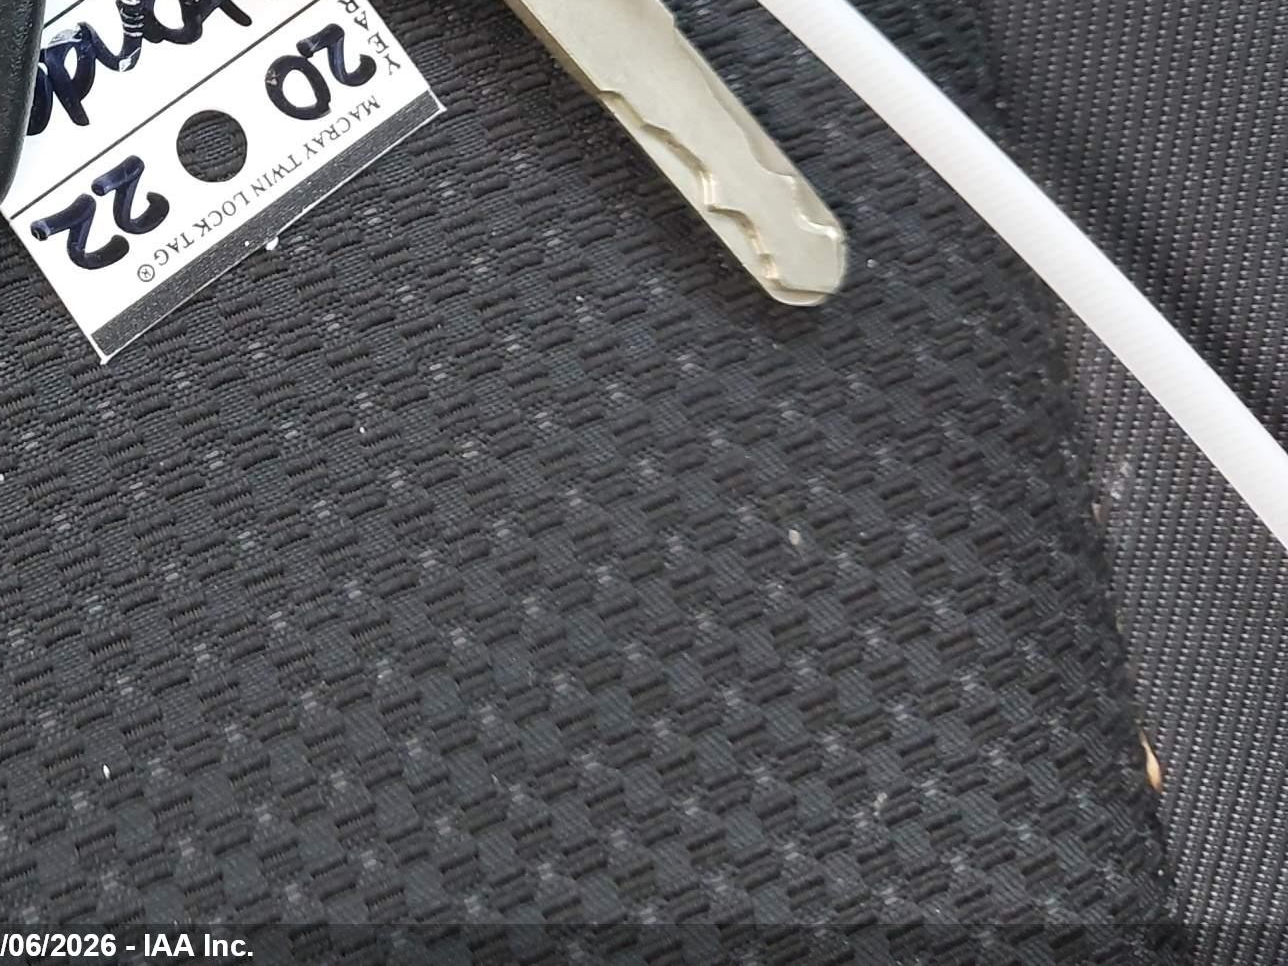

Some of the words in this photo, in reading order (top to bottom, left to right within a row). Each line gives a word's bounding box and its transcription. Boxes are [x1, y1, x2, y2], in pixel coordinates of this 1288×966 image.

[264, 23, 377, 121] 20
[303, 94, 382, 160] MACRAY
[250, 154, 304, 198] TWIN
[30, 154, 170, 270] 22
[191, 192, 251, 240] LOCK
